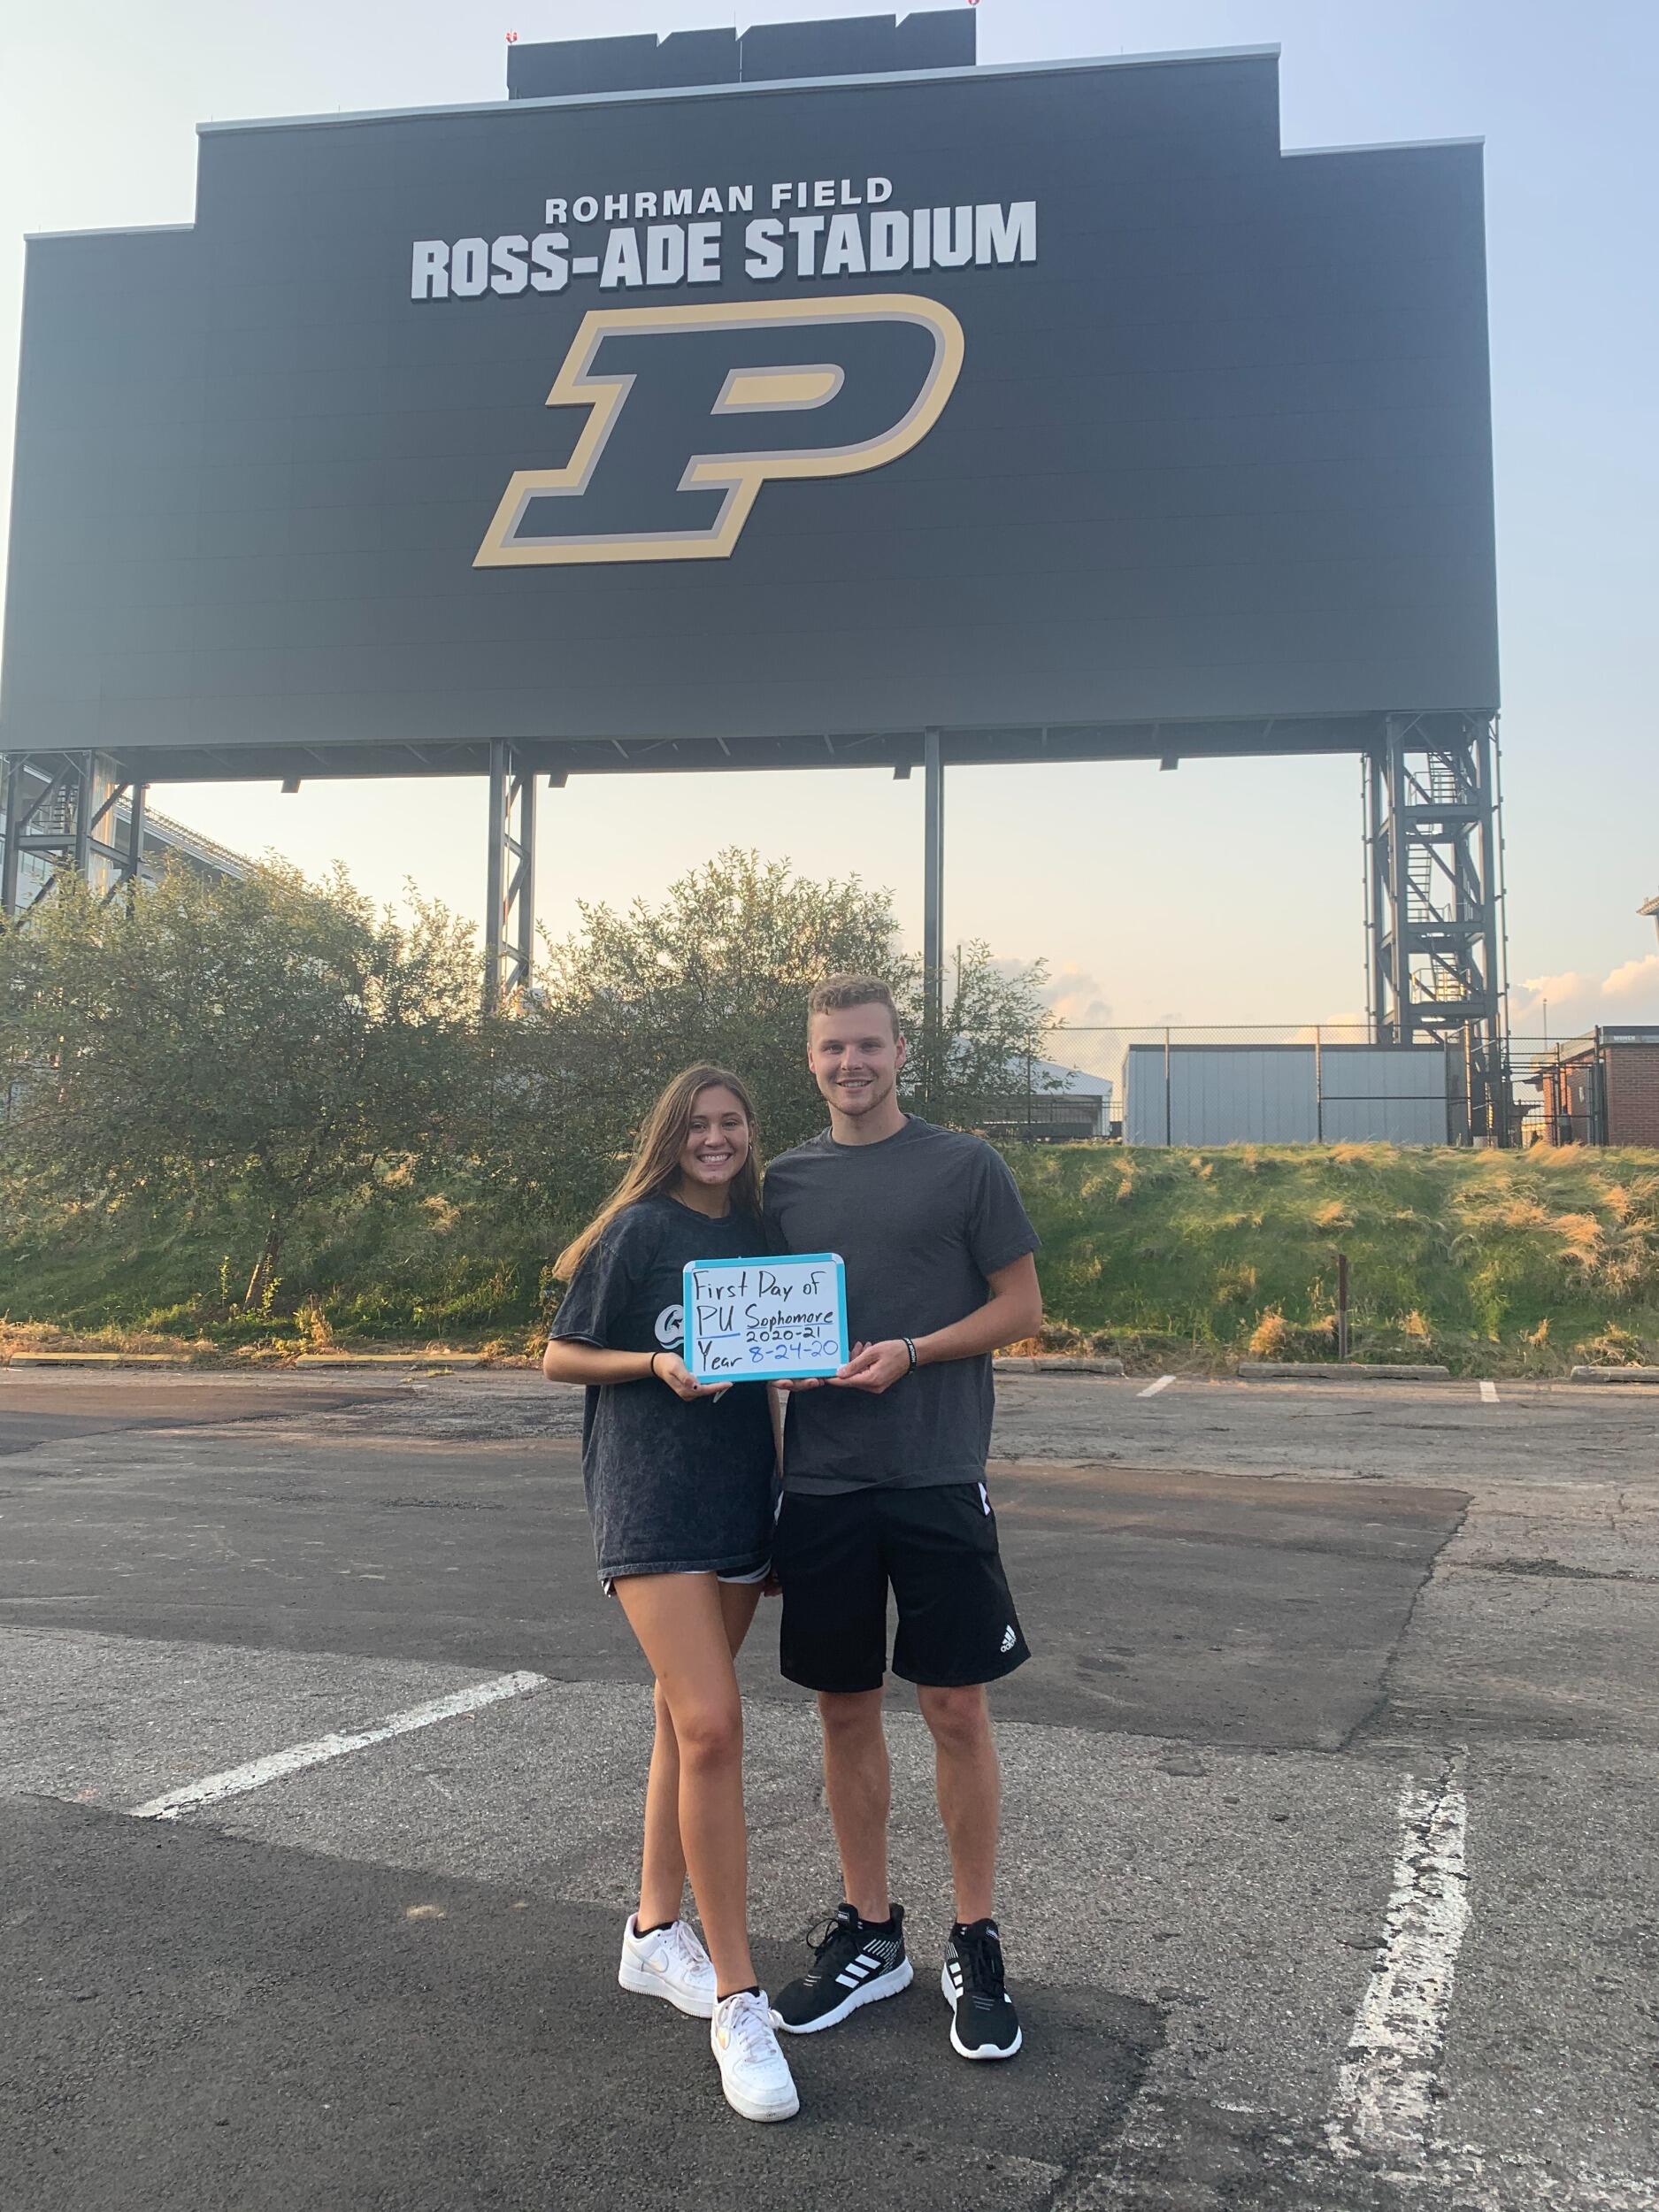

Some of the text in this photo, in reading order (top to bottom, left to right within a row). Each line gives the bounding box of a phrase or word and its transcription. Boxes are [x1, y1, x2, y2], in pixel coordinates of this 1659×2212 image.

[545, 176, 894, 225] ROHRMAN FIELD
[410, 201, 1038, 301] ROSS-ADE STADIUM
[693, 1270, 749, 1300] First
[758, 1271, 793, 1302] Day
[697, 1303, 833, 1336] PU Sophomore
[746, 1326, 820, 1343] 2020-21
[697, 1340, 839, 1371] Year 8-24-20
